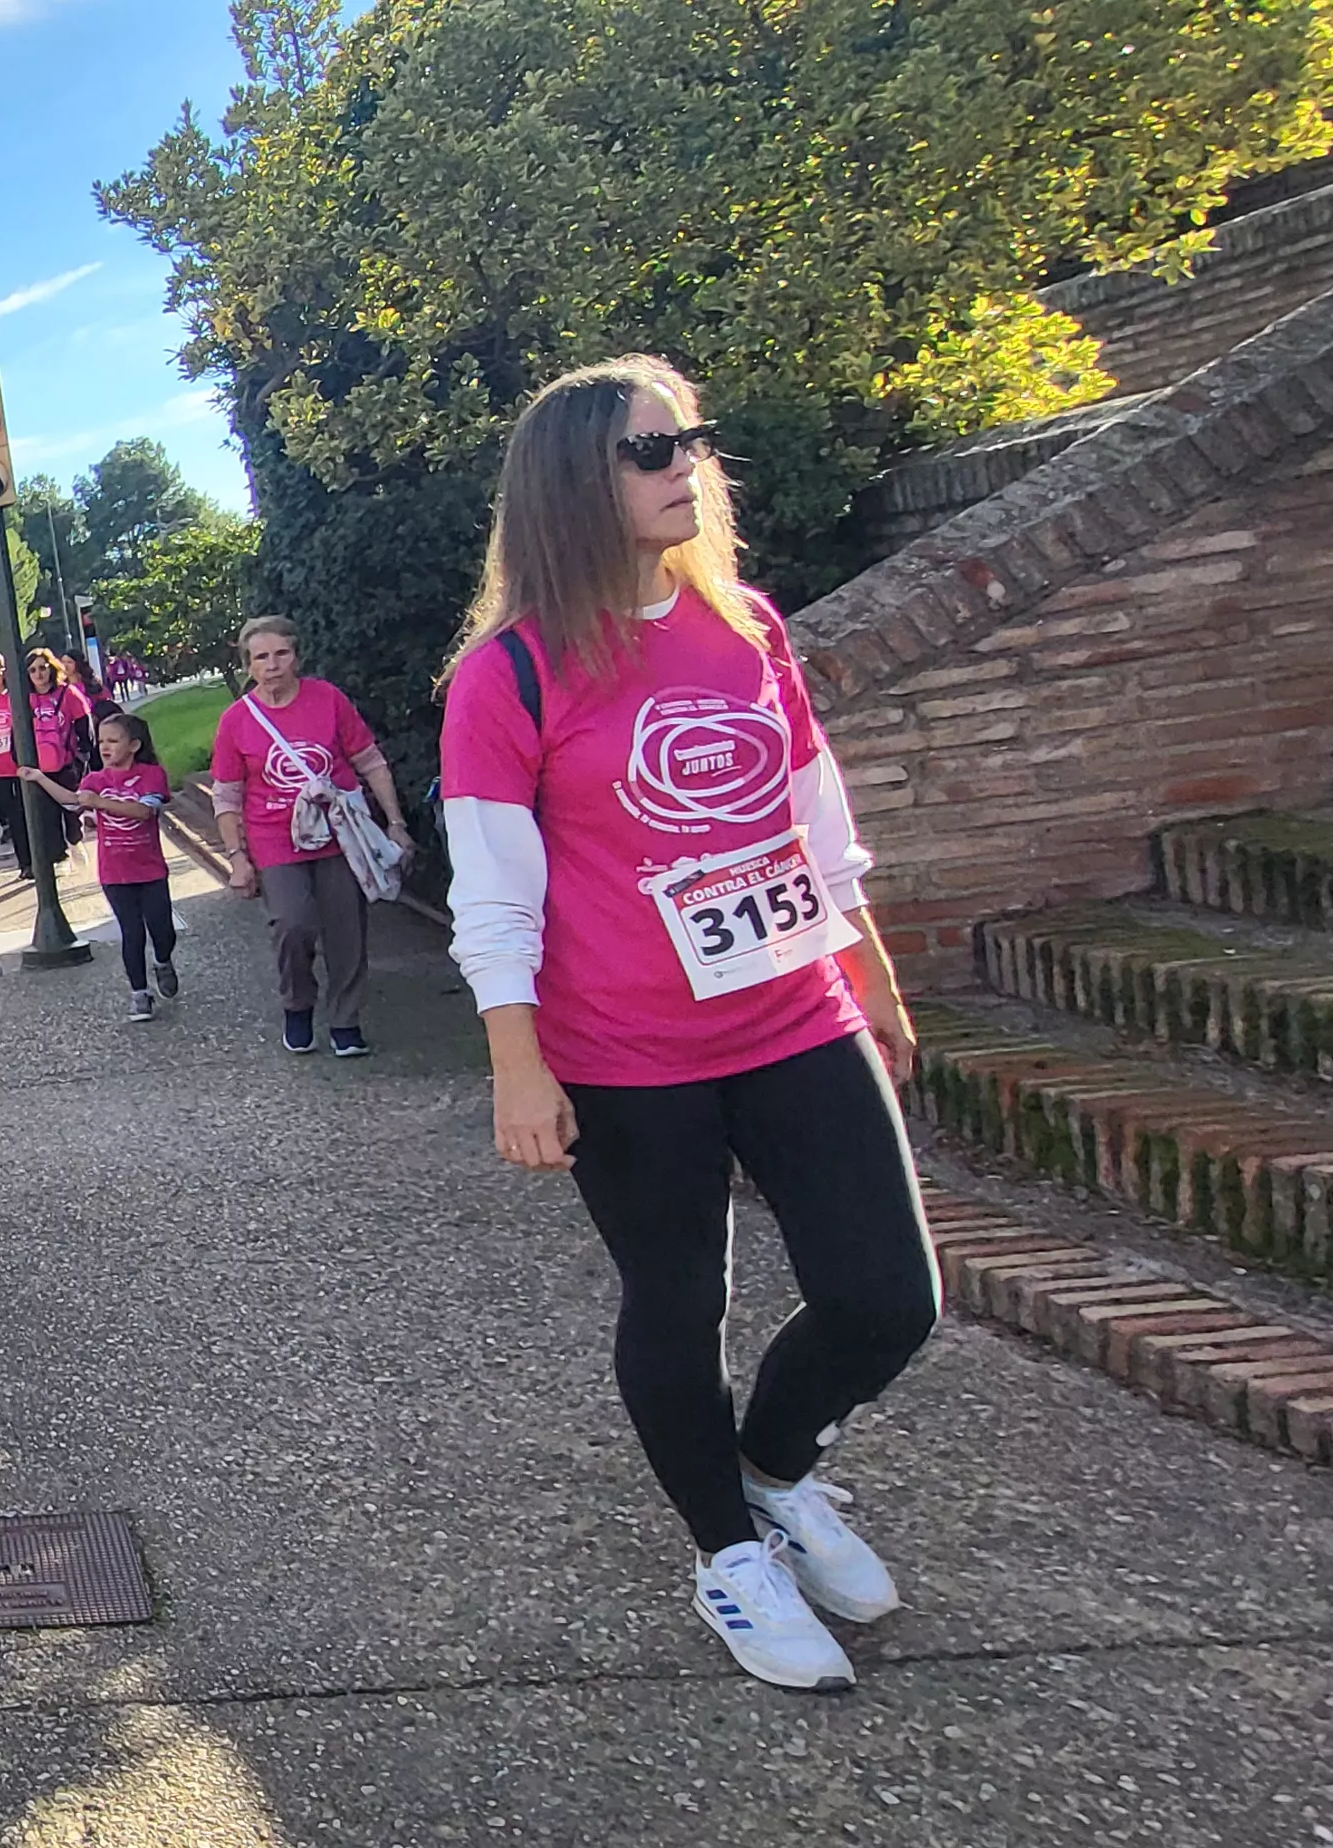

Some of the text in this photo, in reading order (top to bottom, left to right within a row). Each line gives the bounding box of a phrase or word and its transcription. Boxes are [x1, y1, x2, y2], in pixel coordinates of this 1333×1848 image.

[682, 752, 735, 776] JUNTOS
[682, 878, 748, 905] CONTRA
[748, 871, 766, 883] EL
[689, 873, 820, 957] 3153
